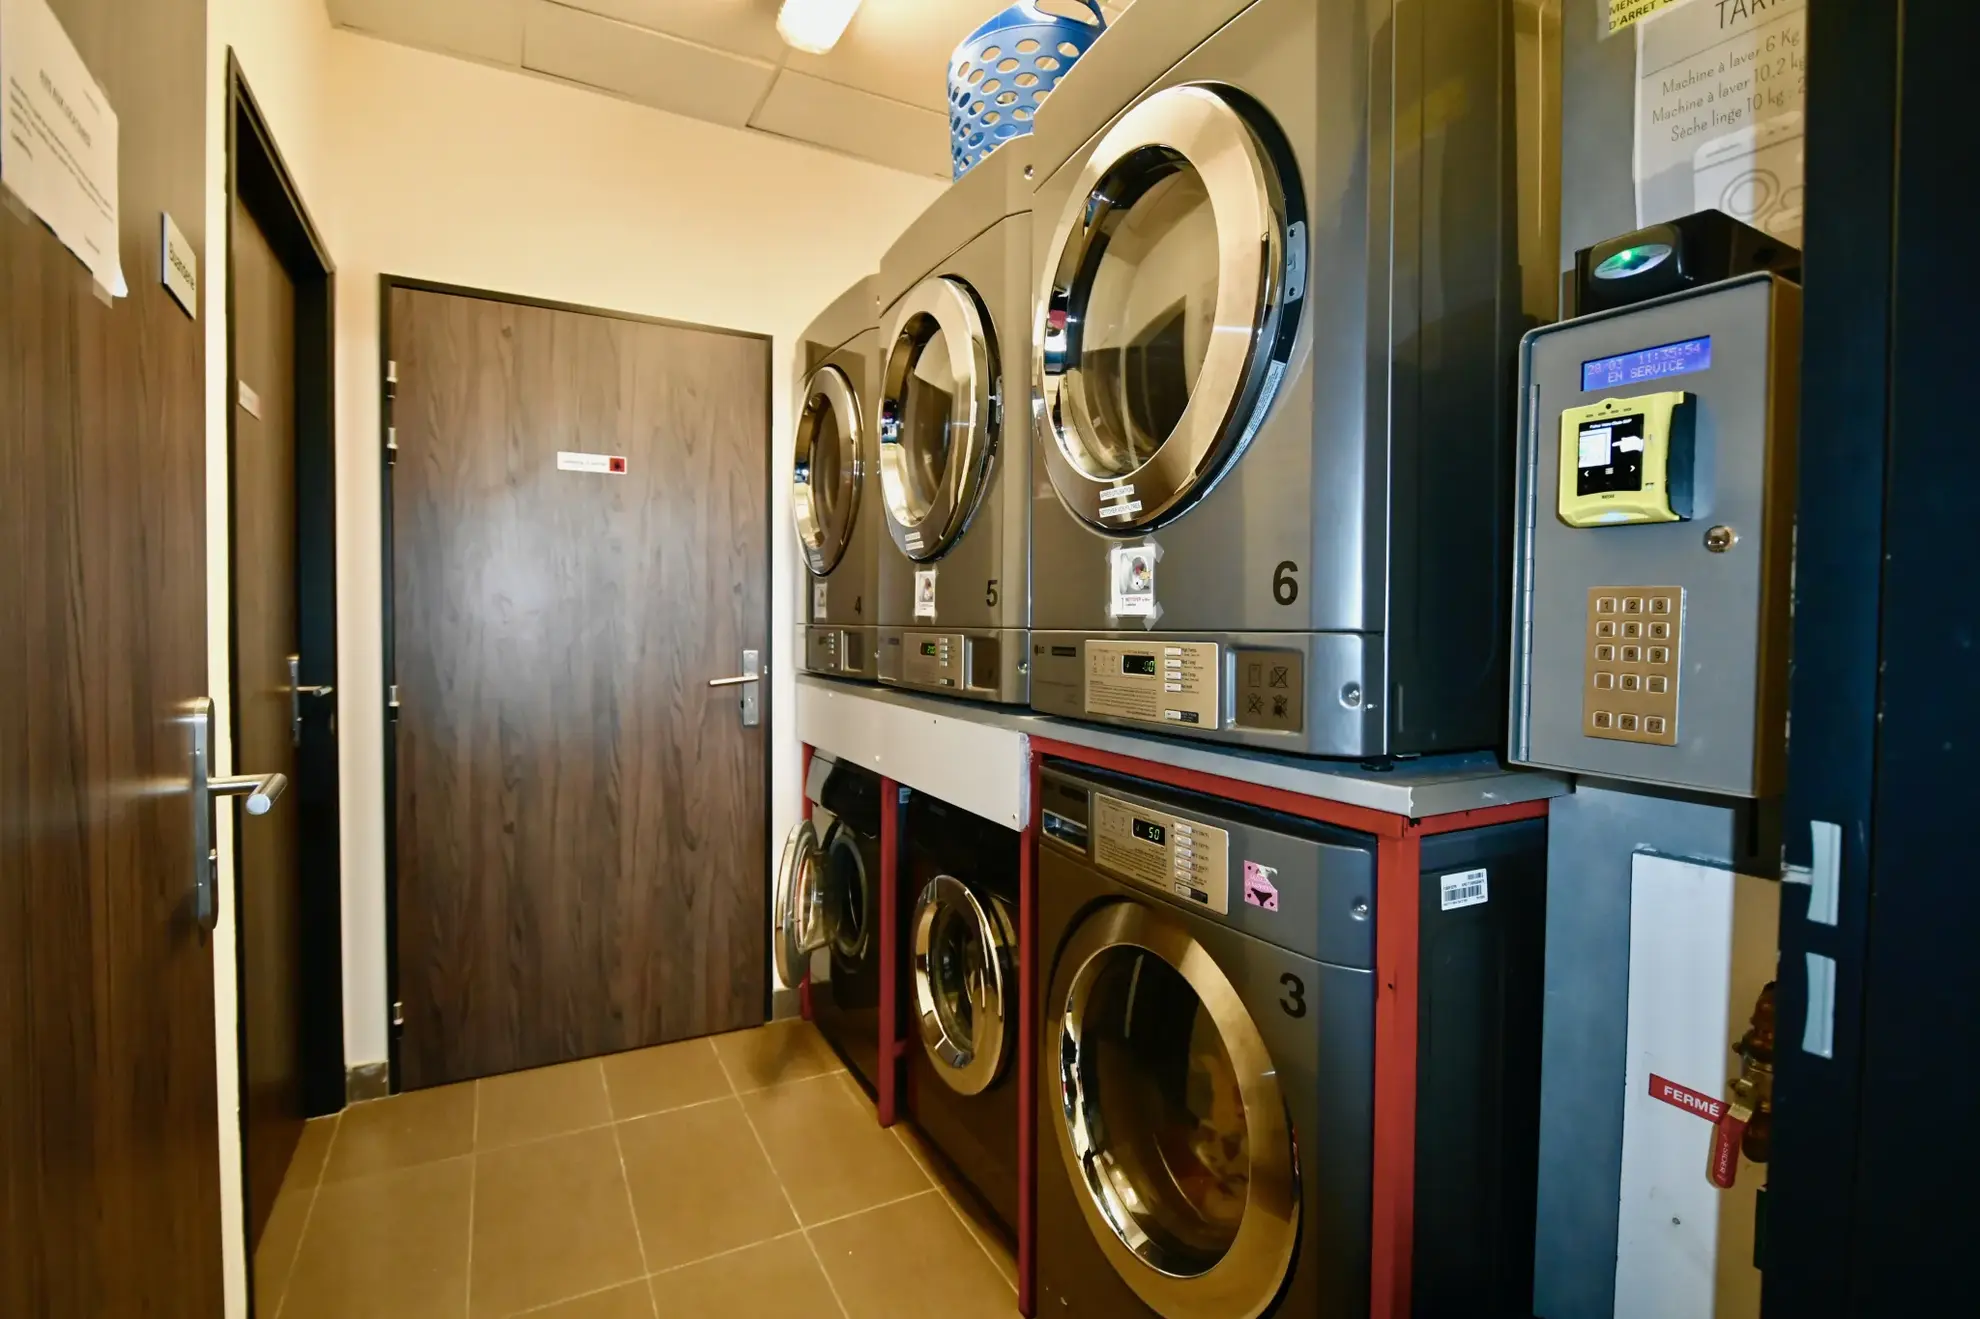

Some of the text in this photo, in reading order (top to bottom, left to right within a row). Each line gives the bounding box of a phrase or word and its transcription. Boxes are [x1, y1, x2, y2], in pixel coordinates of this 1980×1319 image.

[1609, 1, 1656, 31] D'ARRET
[1662, 28, 1800, 96] Machine à laver 6 Kg
[1652, 98, 1704, 125] Machine
[1708, 91, 1714, 103] à
[1719, 78, 1751, 98] laver
[1754, 58, 1786, 83] 10.2
[1671, 116, 1708, 142] Sèche
[1712, 108, 1742, 127] linge
[1747, 93, 1763, 112] 10
[1768, 86, 1784, 107] kg
[1607, 358, 1686, 383] EN SERVICE
[986, 580, 998, 607] 5
[1273, 560, 1299, 606] 6
[854, 596, 863, 615] 4
[1604, 601, 1663, 610] 1 2 3
[1602, 625, 1662, 635] 4 5 6
[1601, 649, 1661, 659] 7 8 9
[1626, 678, 1633, 687] 0
[1622, 718, 1633, 728] F2
[1649, 720, 1660, 730] F3
[1148, 826, 1160, 841] 50
[1279, 972, 1307, 1019] 3
[1664, 1085, 1720, 1117] FERMÉ
